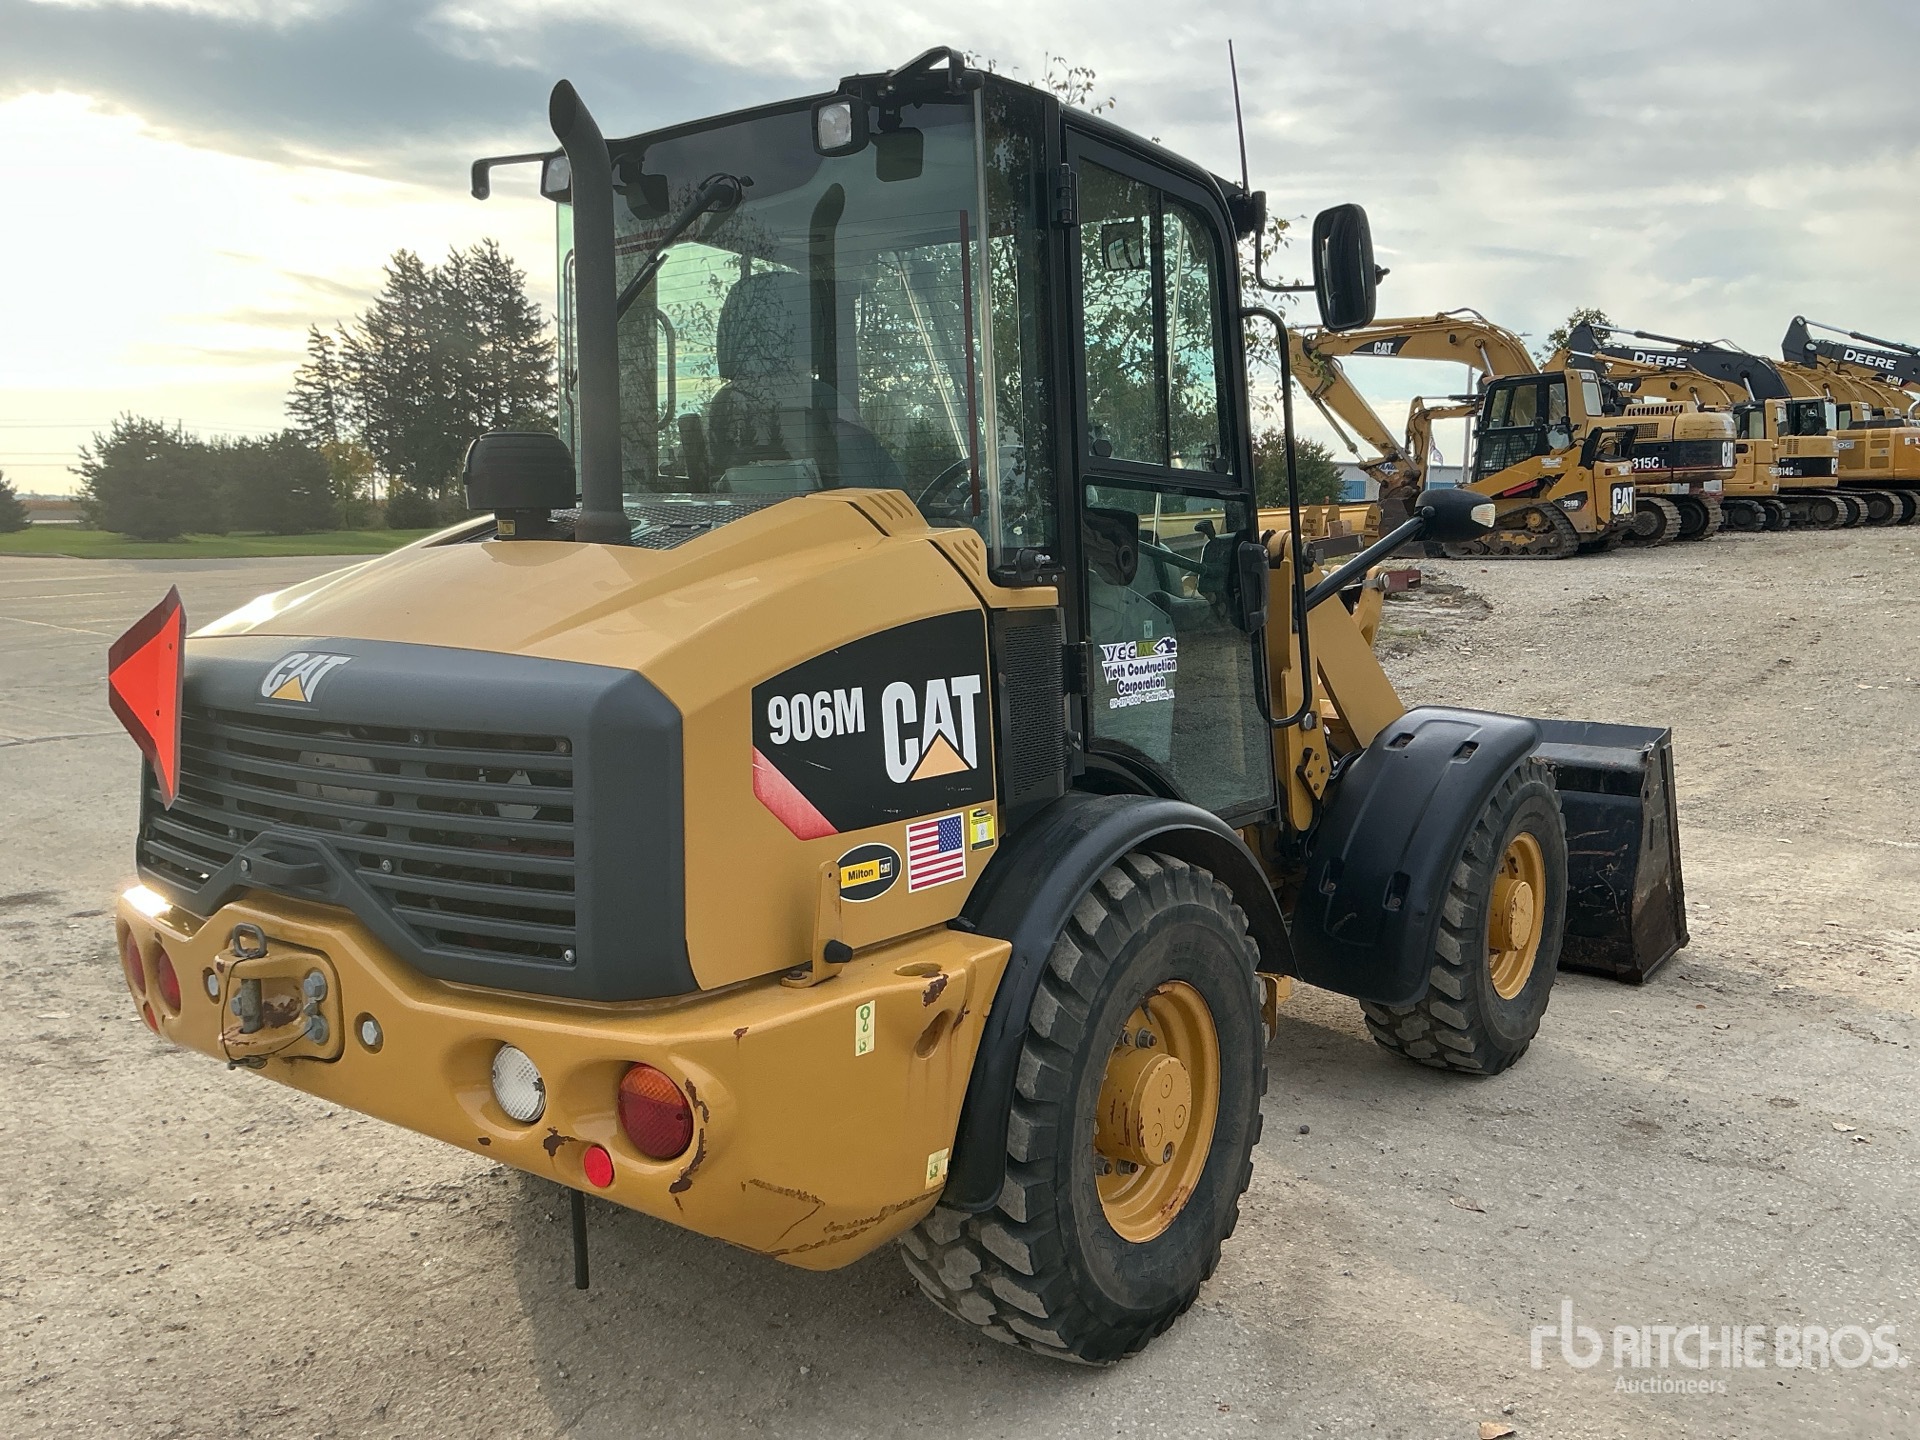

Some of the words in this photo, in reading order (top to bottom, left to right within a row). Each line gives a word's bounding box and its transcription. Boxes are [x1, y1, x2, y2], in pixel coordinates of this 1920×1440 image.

[1373, 341, 1394, 355] CAT
[1633, 351, 1688, 368] DEERE
[1843, 349, 1897, 370] DEERE
[1617, 382, 1634, 393] CAT
[1631, 456, 1659, 469] 315C
[1612, 486, 1634, 515] CAT
[261, 653, 352, 703] CAT
[1104, 665, 1126, 679] Vieth
[1127, 659, 1176, 676] Construction
[1118, 677, 1165, 694] Corporation
[767, 686, 866, 745] 906M
[881, 674, 981, 783] CAT
[847, 869, 874, 881] Milton
[880, 862, 891, 874] CAT
